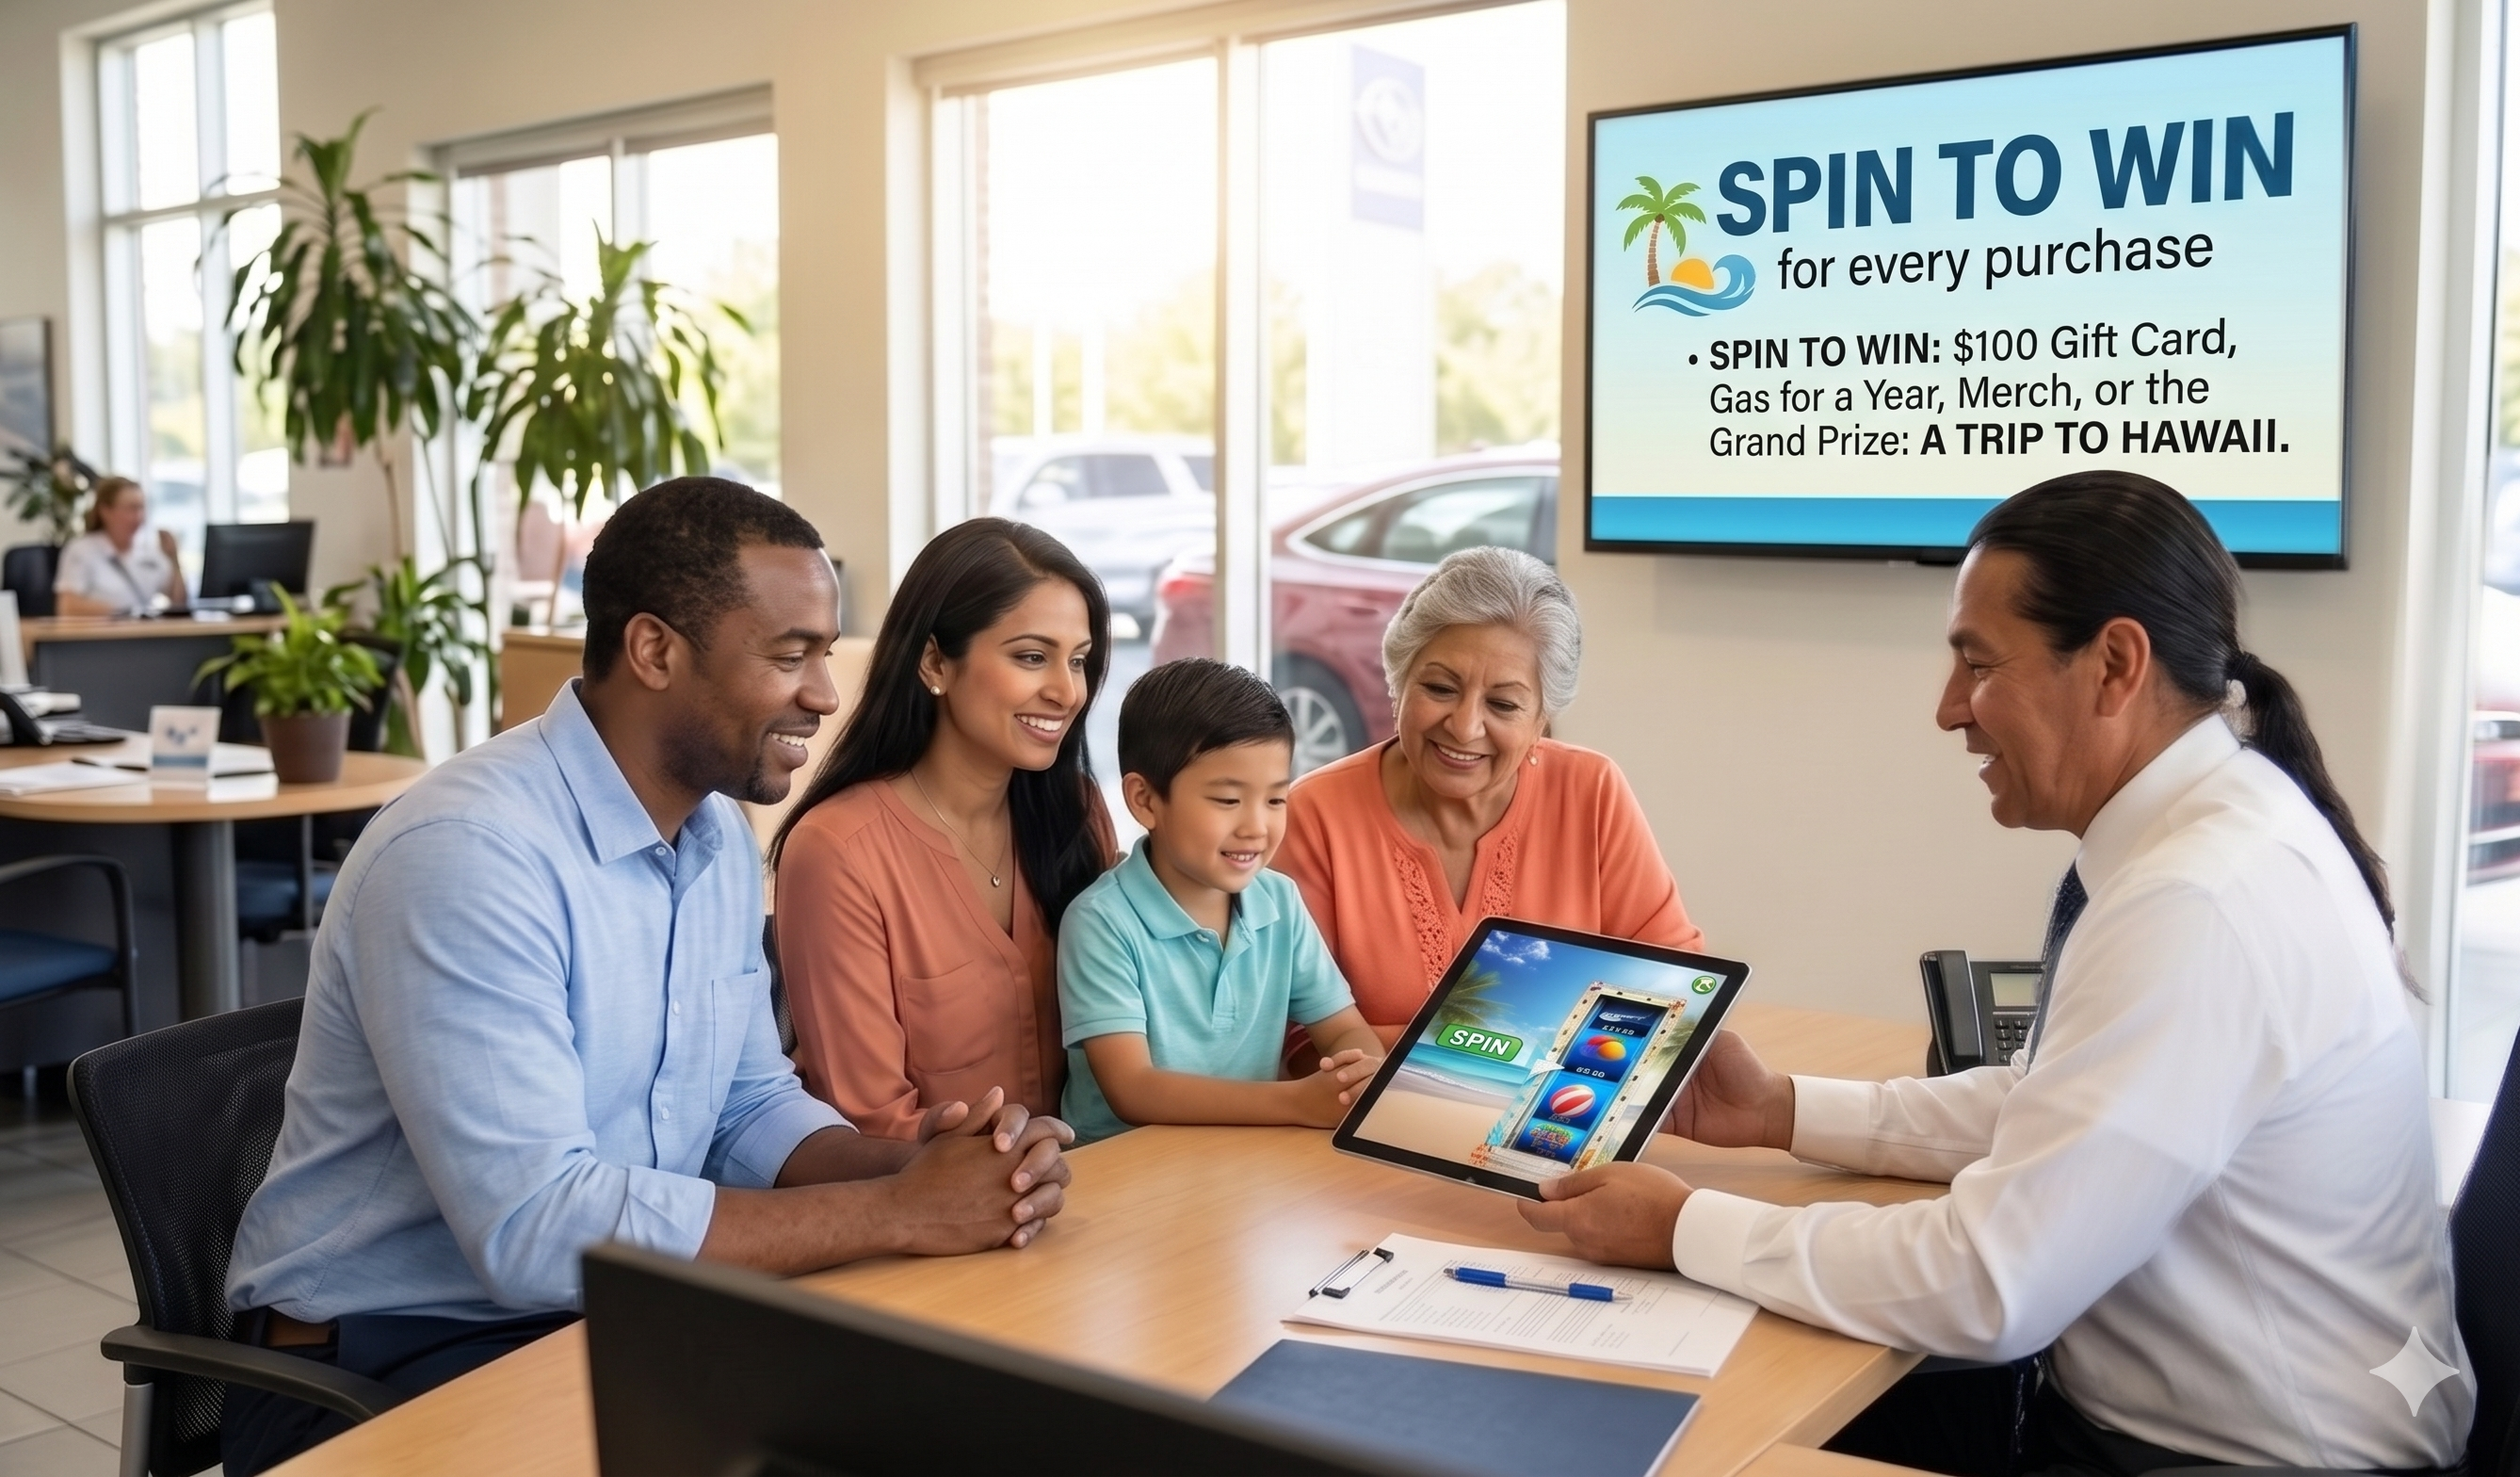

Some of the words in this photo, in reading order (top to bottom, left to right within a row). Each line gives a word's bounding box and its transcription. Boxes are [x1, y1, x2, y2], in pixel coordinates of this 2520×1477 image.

[1716, 146, 1913, 236] SPIN
[1938, 134, 2061, 220] TO
[2089, 111, 2295, 210] WIN
[1777, 247, 1835, 289] for
[1849, 247, 1970, 292] every
[1985, 227, 2214, 291] purchase
[1709, 335, 1790, 371] SPIN
[1799, 335, 1846, 367] TO
[1856, 333, 1941, 366] WIN:
[1952, 328, 2039, 366] $100
[2051, 322, 2119, 360] Gift
[2131, 317, 2237, 359] Card,
[1709, 383, 1770, 414] Gas
[1780, 380, 1825, 413] for
[1834, 387, 1852, 412] a
[1863, 379, 1946, 414] Year,
[1958, 376, 2081, 412] Merch,
[2095, 380, 2135, 407] or
[2145, 368, 2209, 406] the
[1709, 426, 1805, 457] Grand
[1818, 425, 1908, 457] Prize:
[1920, 424, 1947, 456] A
[1955, 422, 2044, 456] TRIP
[2054, 420, 2108, 454] TO
[2122, 418, 2290, 454] HAWAII.
[1449, 1029, 1510, 1056] SPIN
